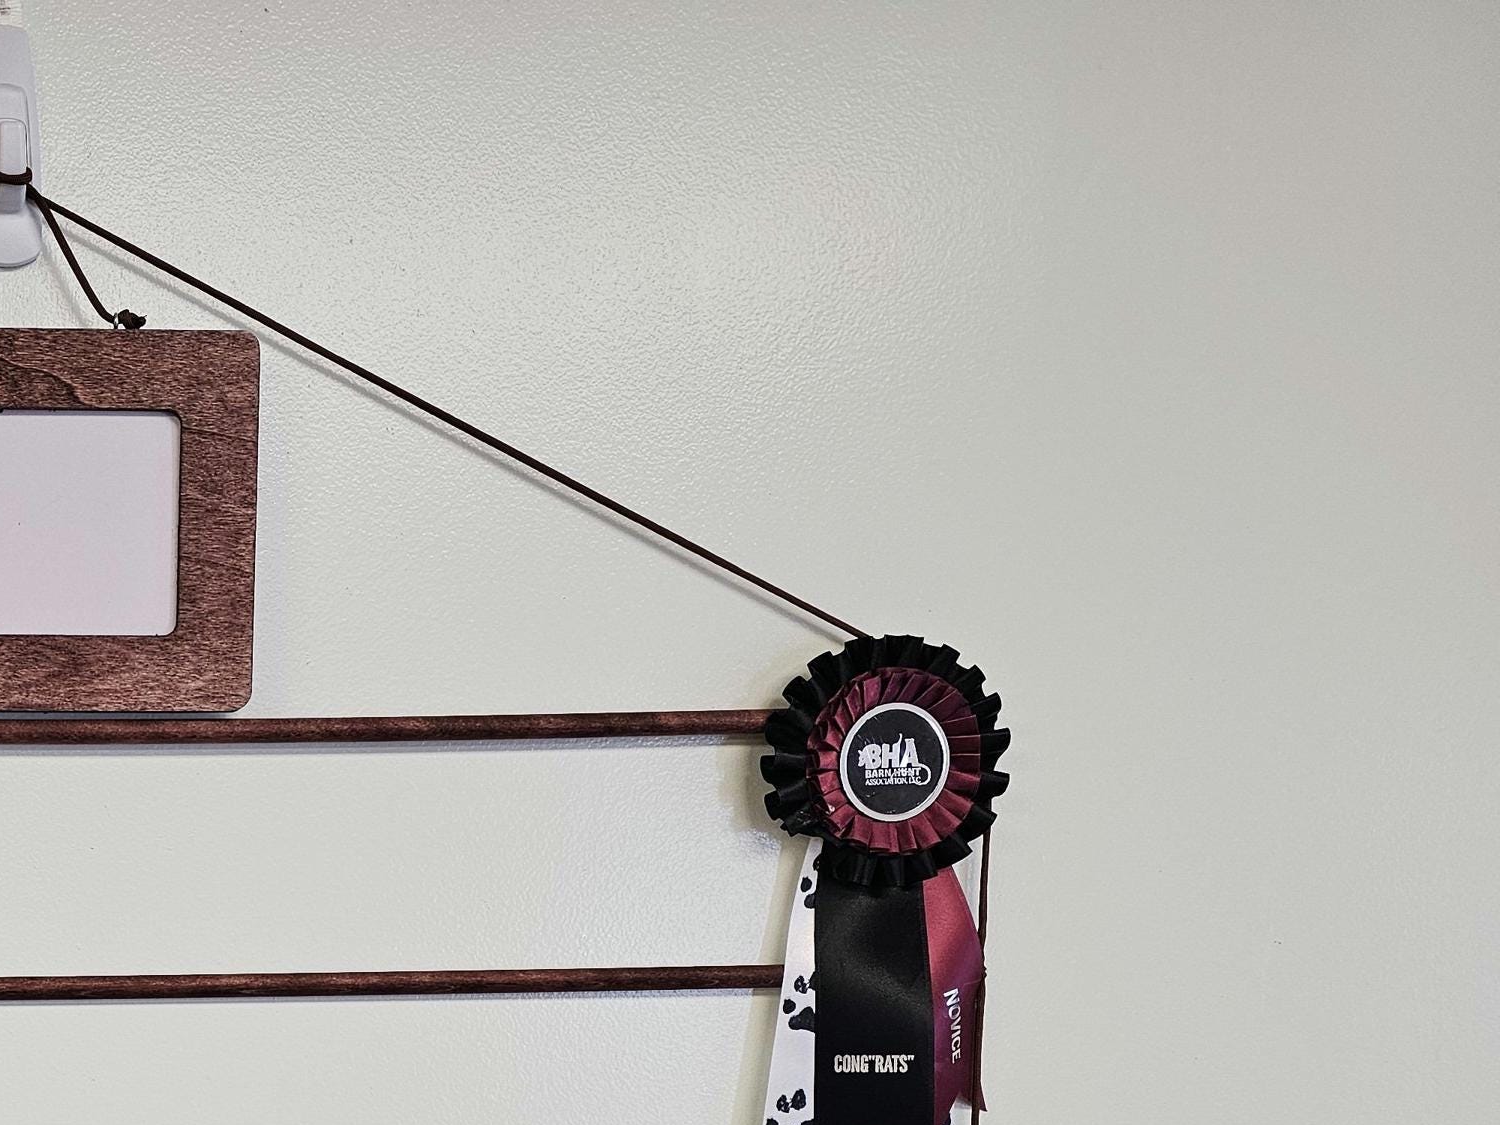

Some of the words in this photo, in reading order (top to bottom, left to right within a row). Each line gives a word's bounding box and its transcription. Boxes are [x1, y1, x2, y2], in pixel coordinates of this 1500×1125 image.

[859, 739, 919, 769] BHA
[865, 769, 891, 779] BARN
[943, 987, 962, 1065] NOVICE
